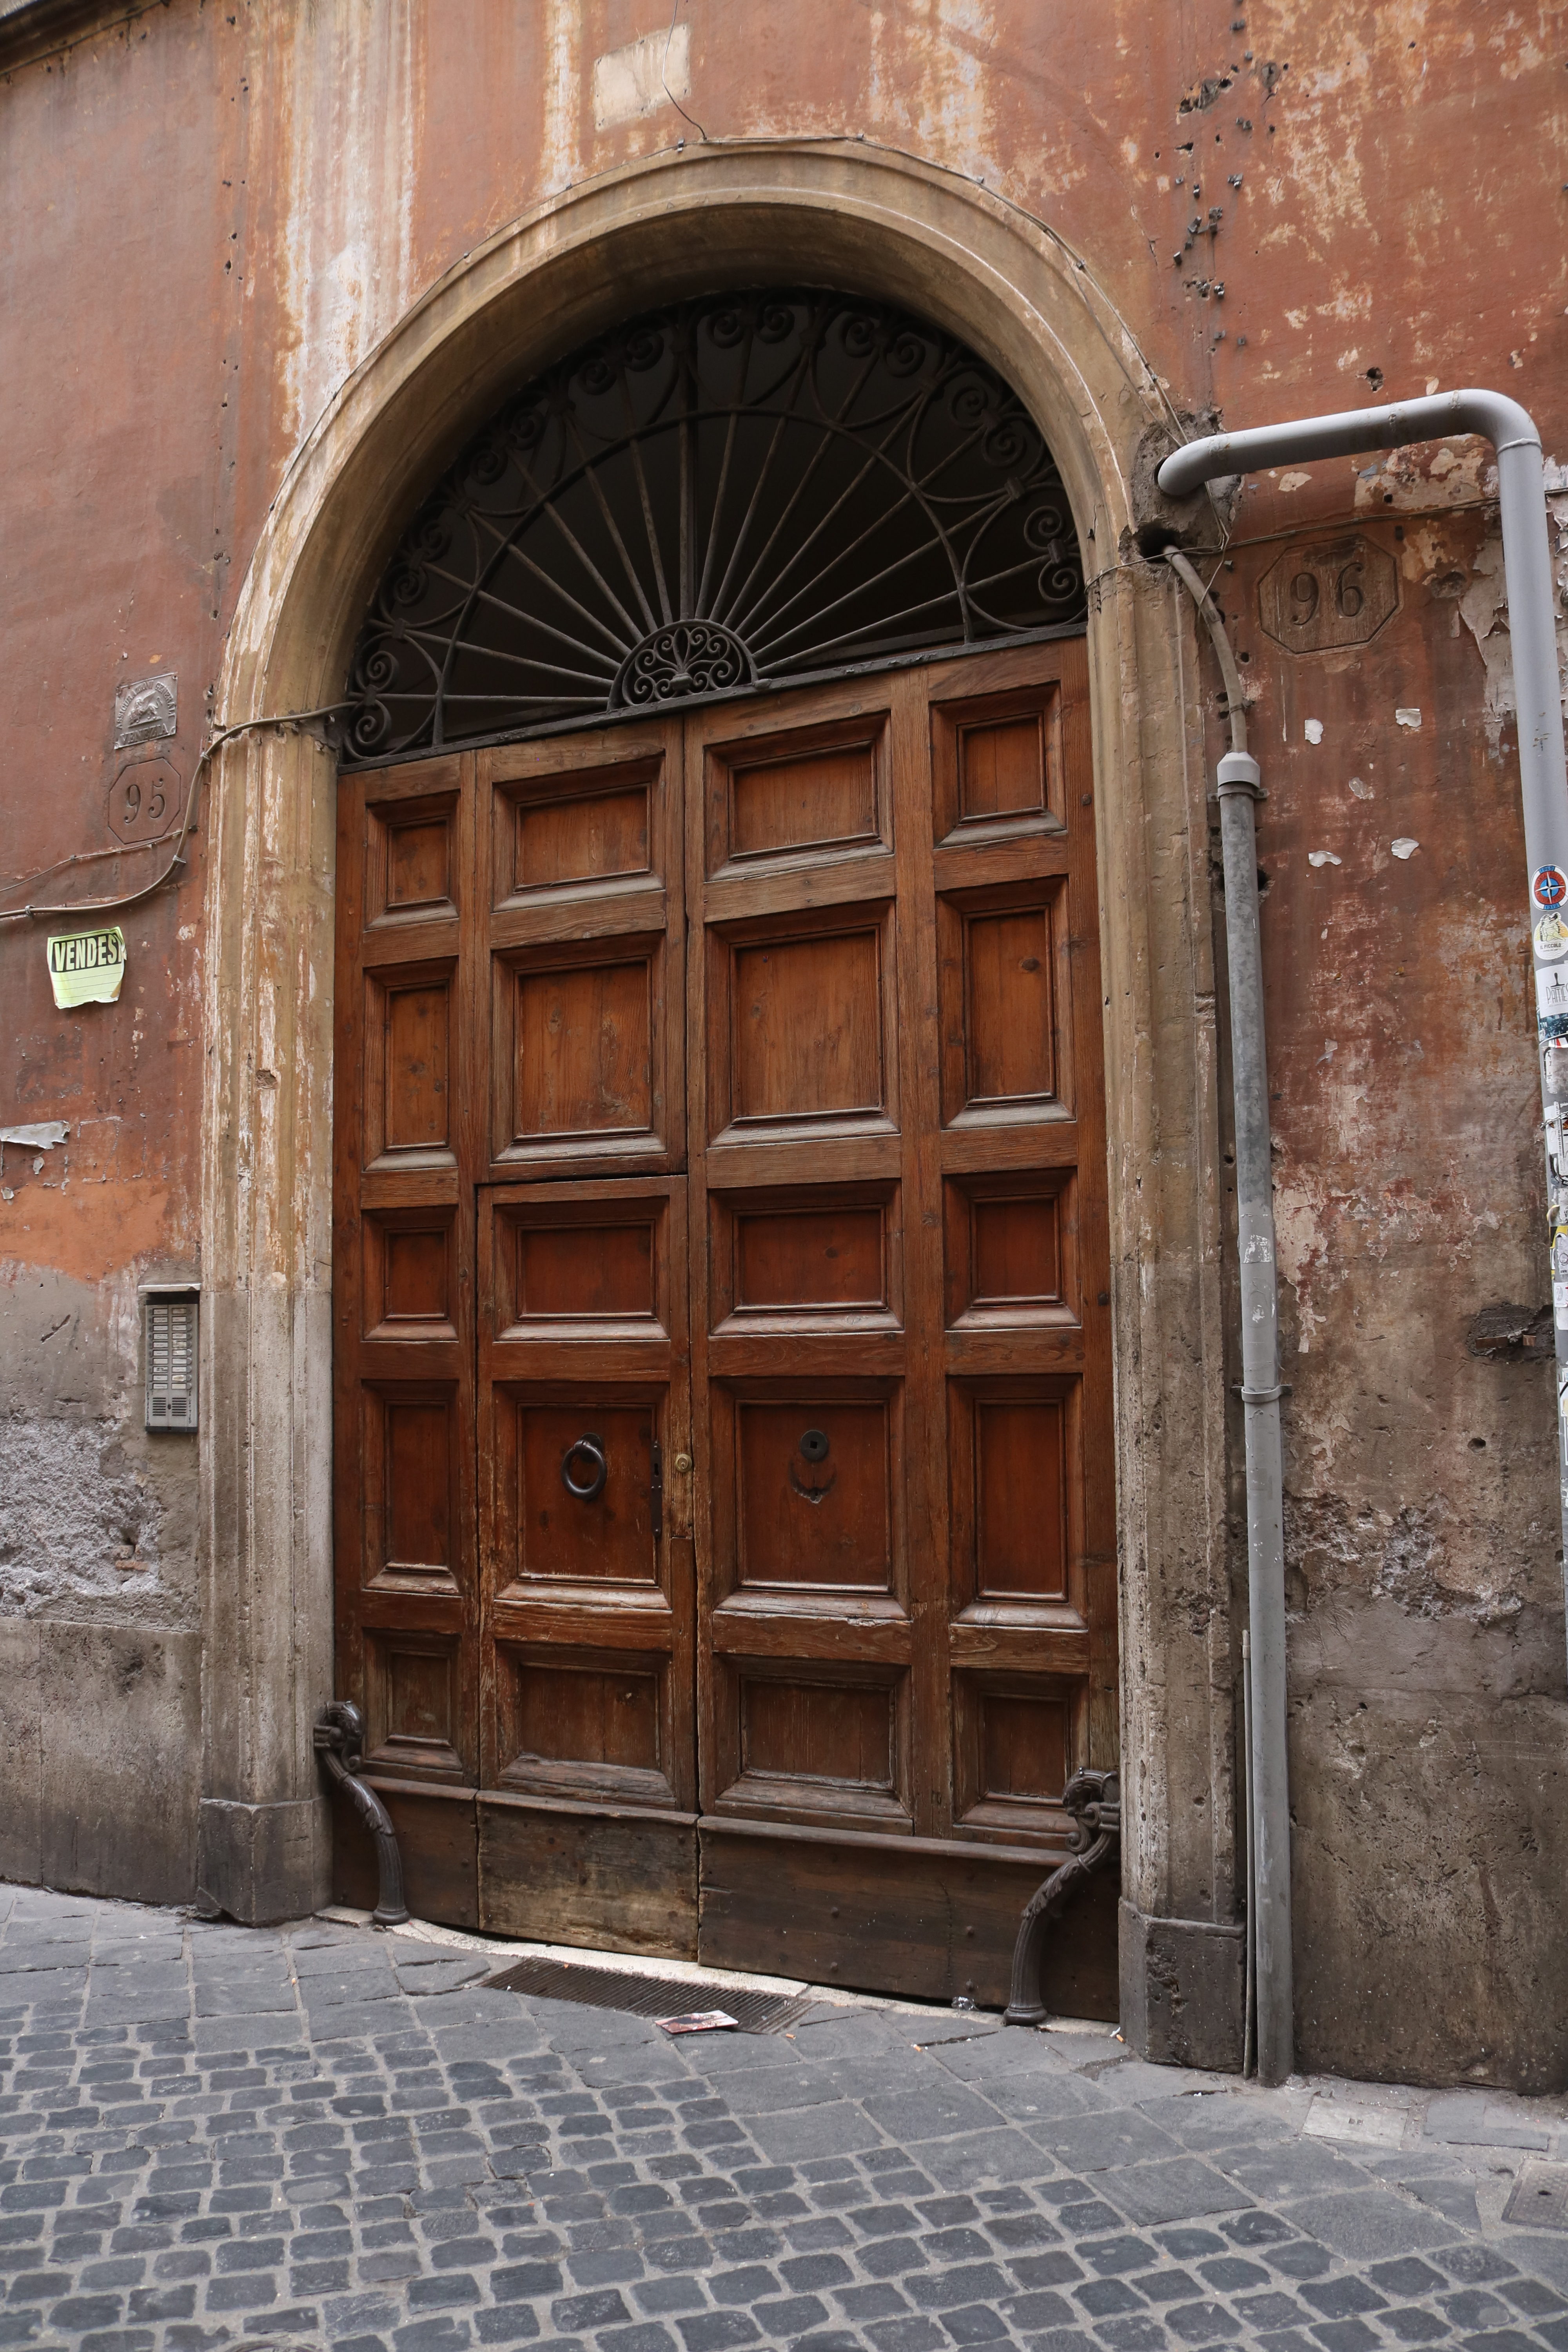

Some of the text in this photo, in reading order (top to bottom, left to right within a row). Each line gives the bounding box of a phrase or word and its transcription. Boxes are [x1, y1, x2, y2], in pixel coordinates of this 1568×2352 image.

[1290, 562, 1364, 626] 96
[155, 681, 176, 718] GENERALI
[120, 723, 169, 743] VENEZIA
[124, 778, 165, 824] 95
[54, 934, 122, 972] VENDESI
